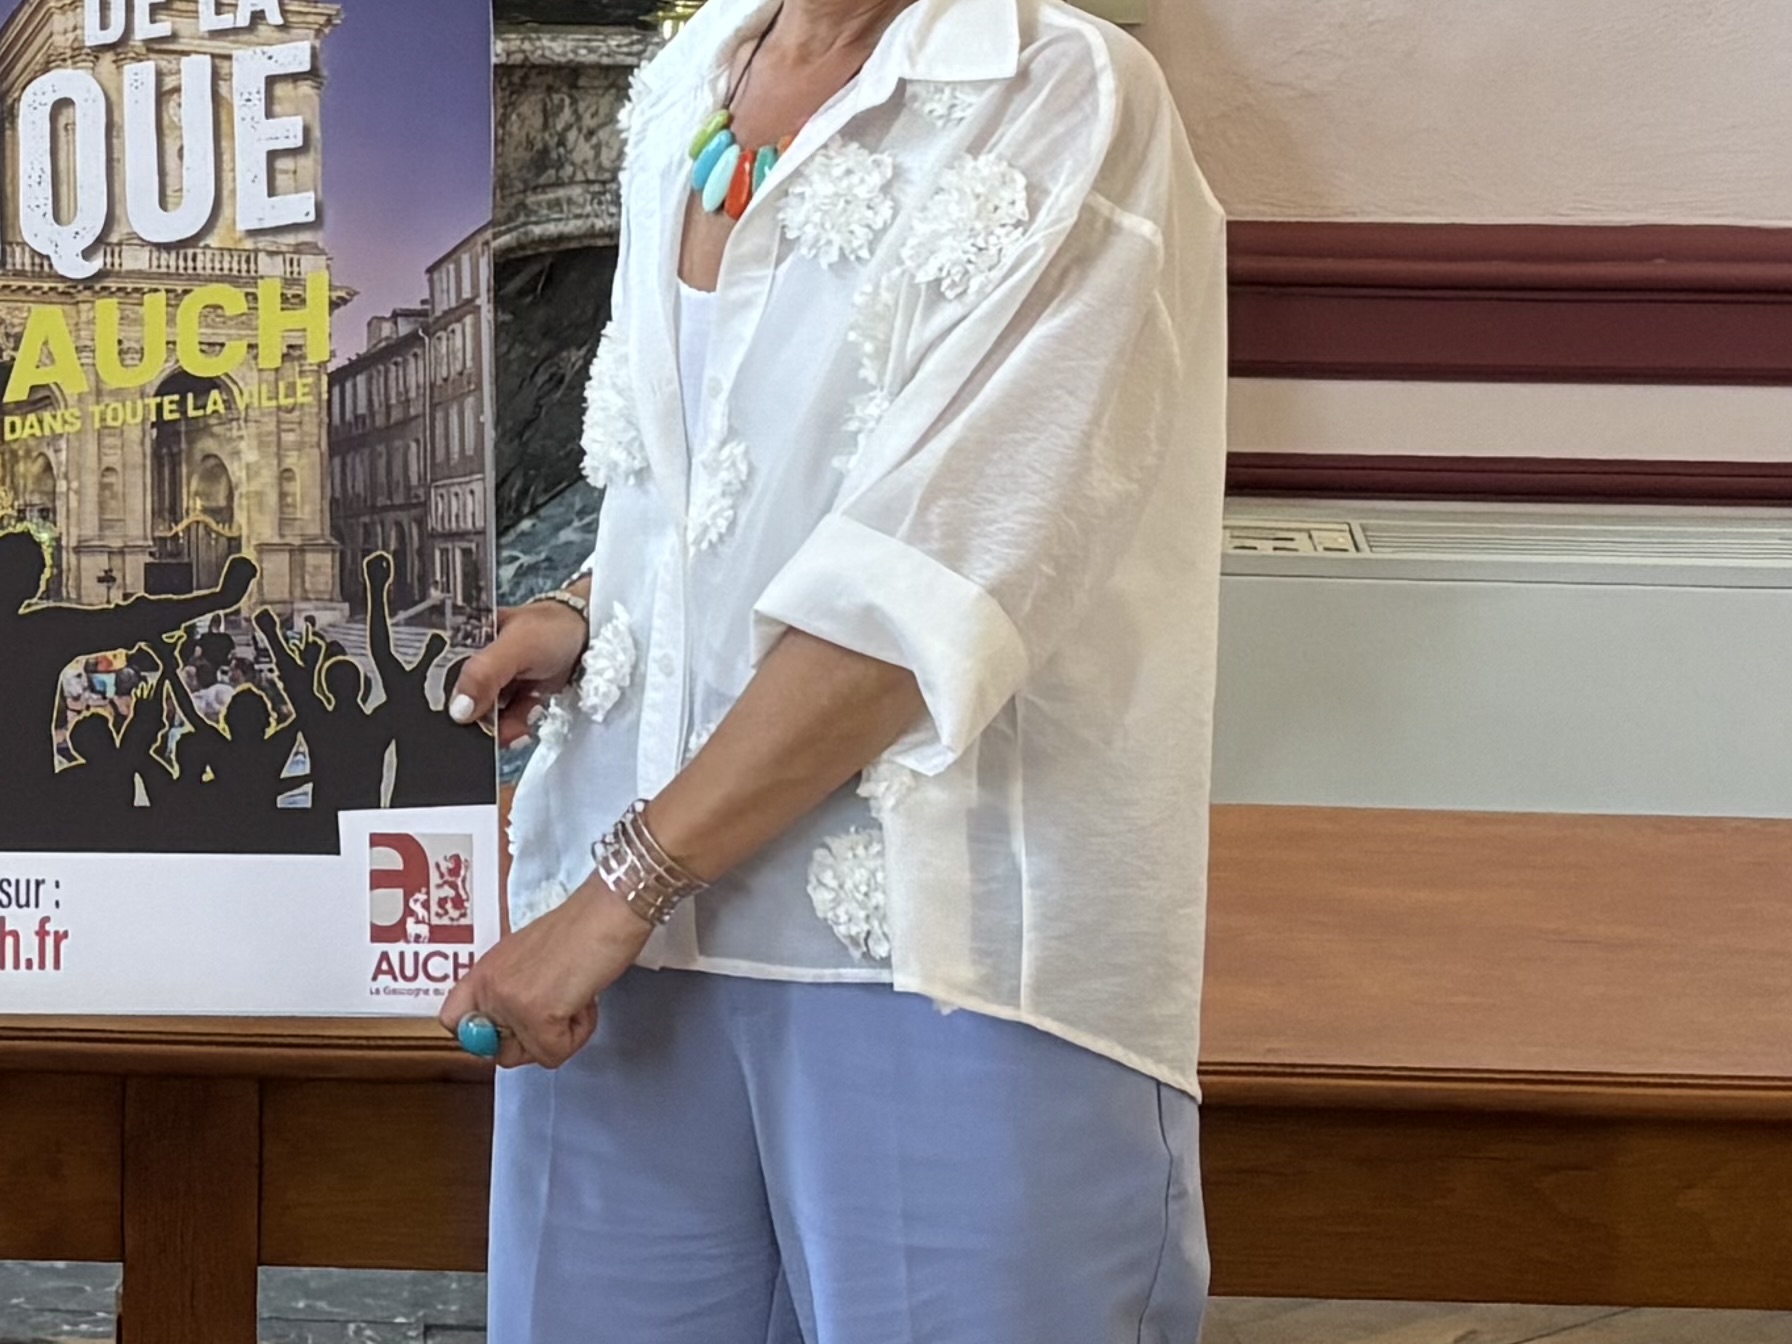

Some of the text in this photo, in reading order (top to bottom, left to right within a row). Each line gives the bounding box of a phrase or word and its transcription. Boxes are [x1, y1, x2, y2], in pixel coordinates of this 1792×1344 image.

[3, 270, 331, 403] AUCH
[4, 410, 82, 442] DANS
[92, 393, 180, 430] TOUTE
[186, 388, 225, 419] LA
[235, 377, 314, 411] VILLE
[371, 950, 475, 982] AUCH
